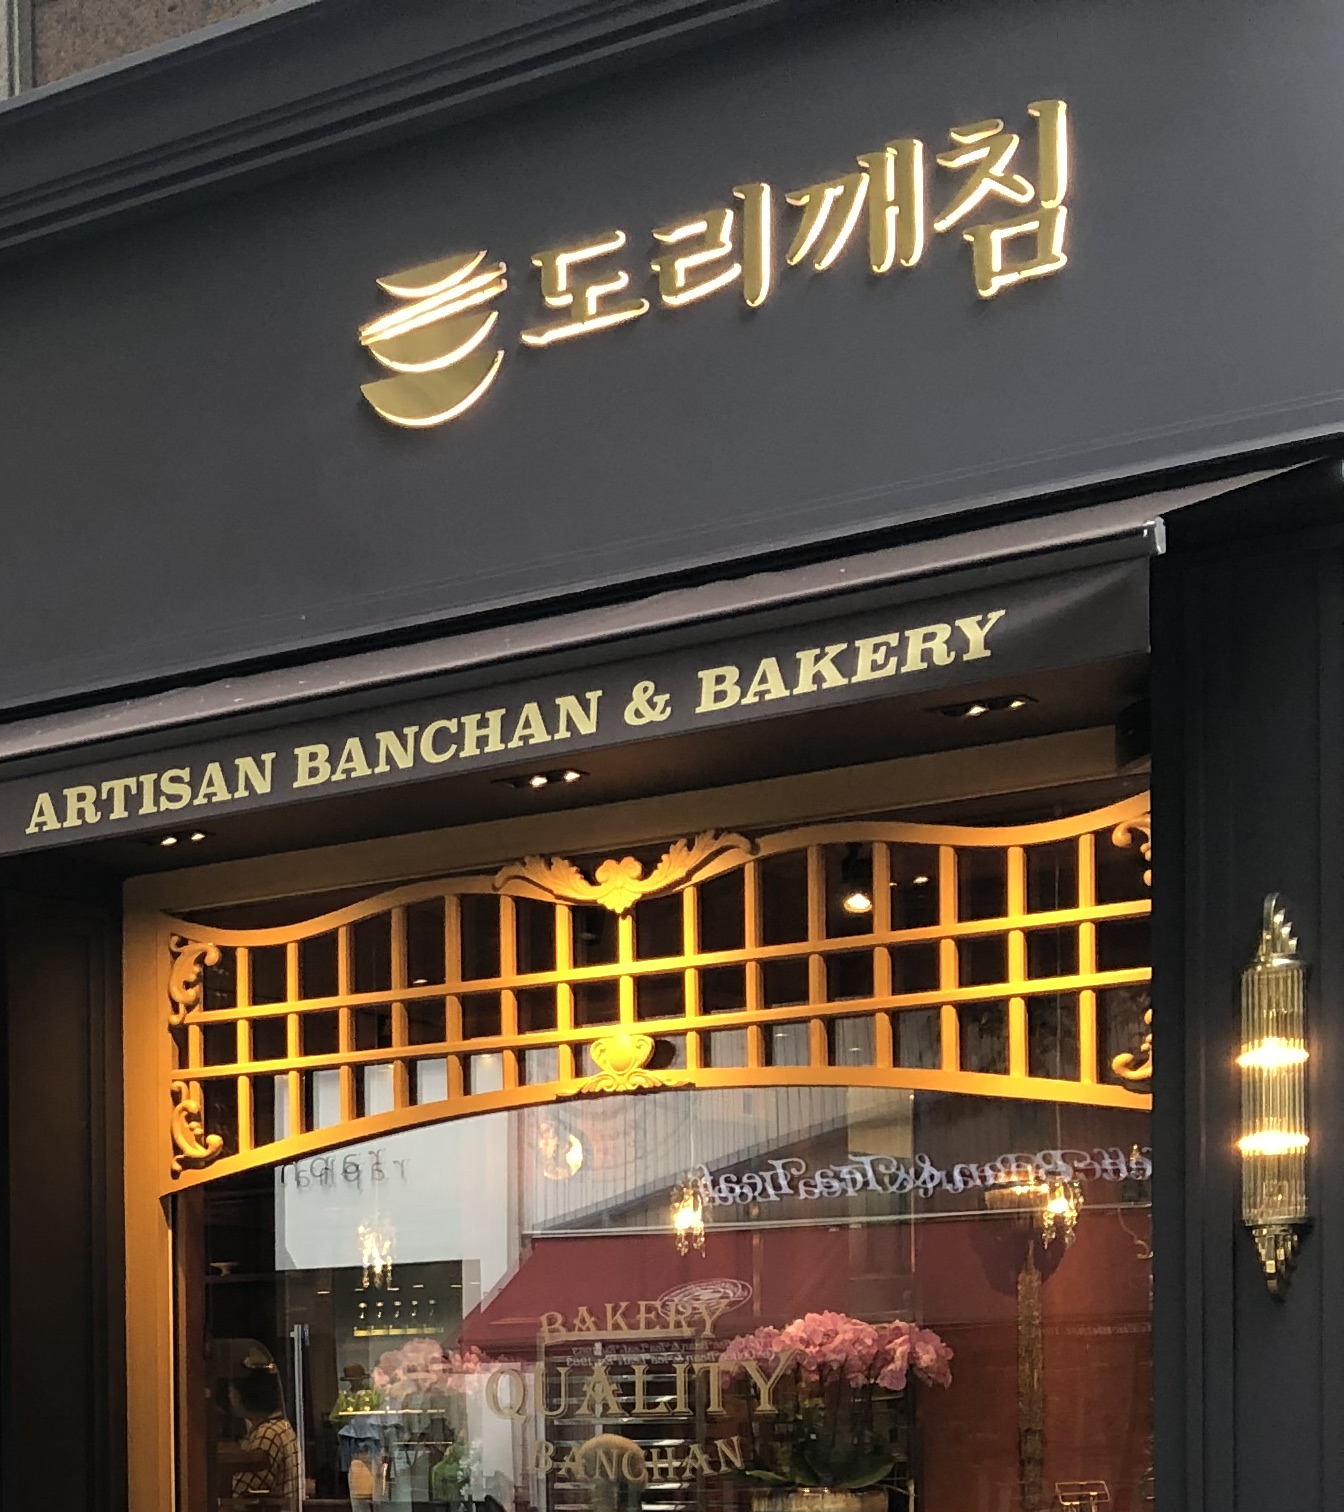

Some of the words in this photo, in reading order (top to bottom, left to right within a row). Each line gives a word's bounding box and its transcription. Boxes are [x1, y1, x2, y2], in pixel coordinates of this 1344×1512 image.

[521, 98, 1070, 345] 도리깨침
[25, 752, 275, 836] ARTISAN
[292, 690, 603, 790] BANCHAN
[624, 680, 673, 726] &
[696, 608, 1008, 716] BAKERY
[540, 1299, 731, 1338] BAKERY
[485, 1347, 801, 1424] QUALITY
[531, 1436, 744, 1484] BANCHAN
